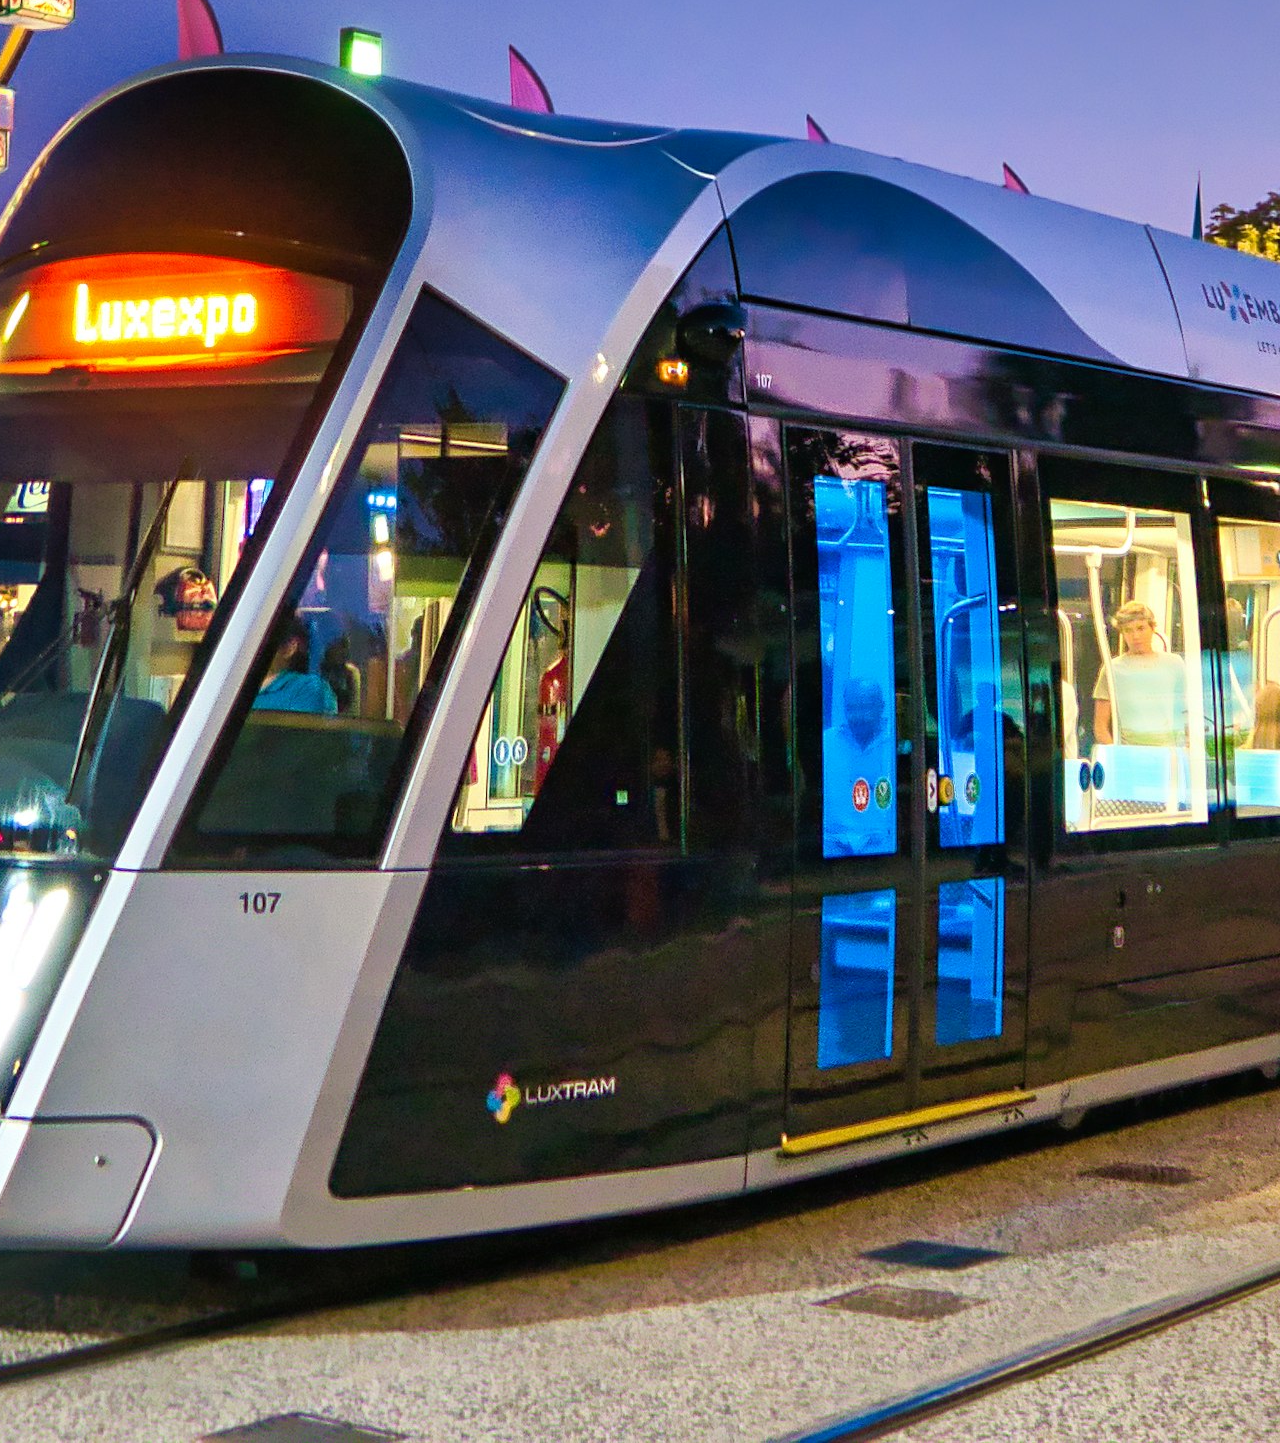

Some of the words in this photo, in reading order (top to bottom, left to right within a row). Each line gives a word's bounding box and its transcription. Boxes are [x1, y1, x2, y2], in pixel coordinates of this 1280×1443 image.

[73, 282, 258, 348] Luxexpo
[755, 372, 773, 389] 107
[239, 892, 282, 914] 107
[525, 1076, 616, 1105] LUXTRAM
